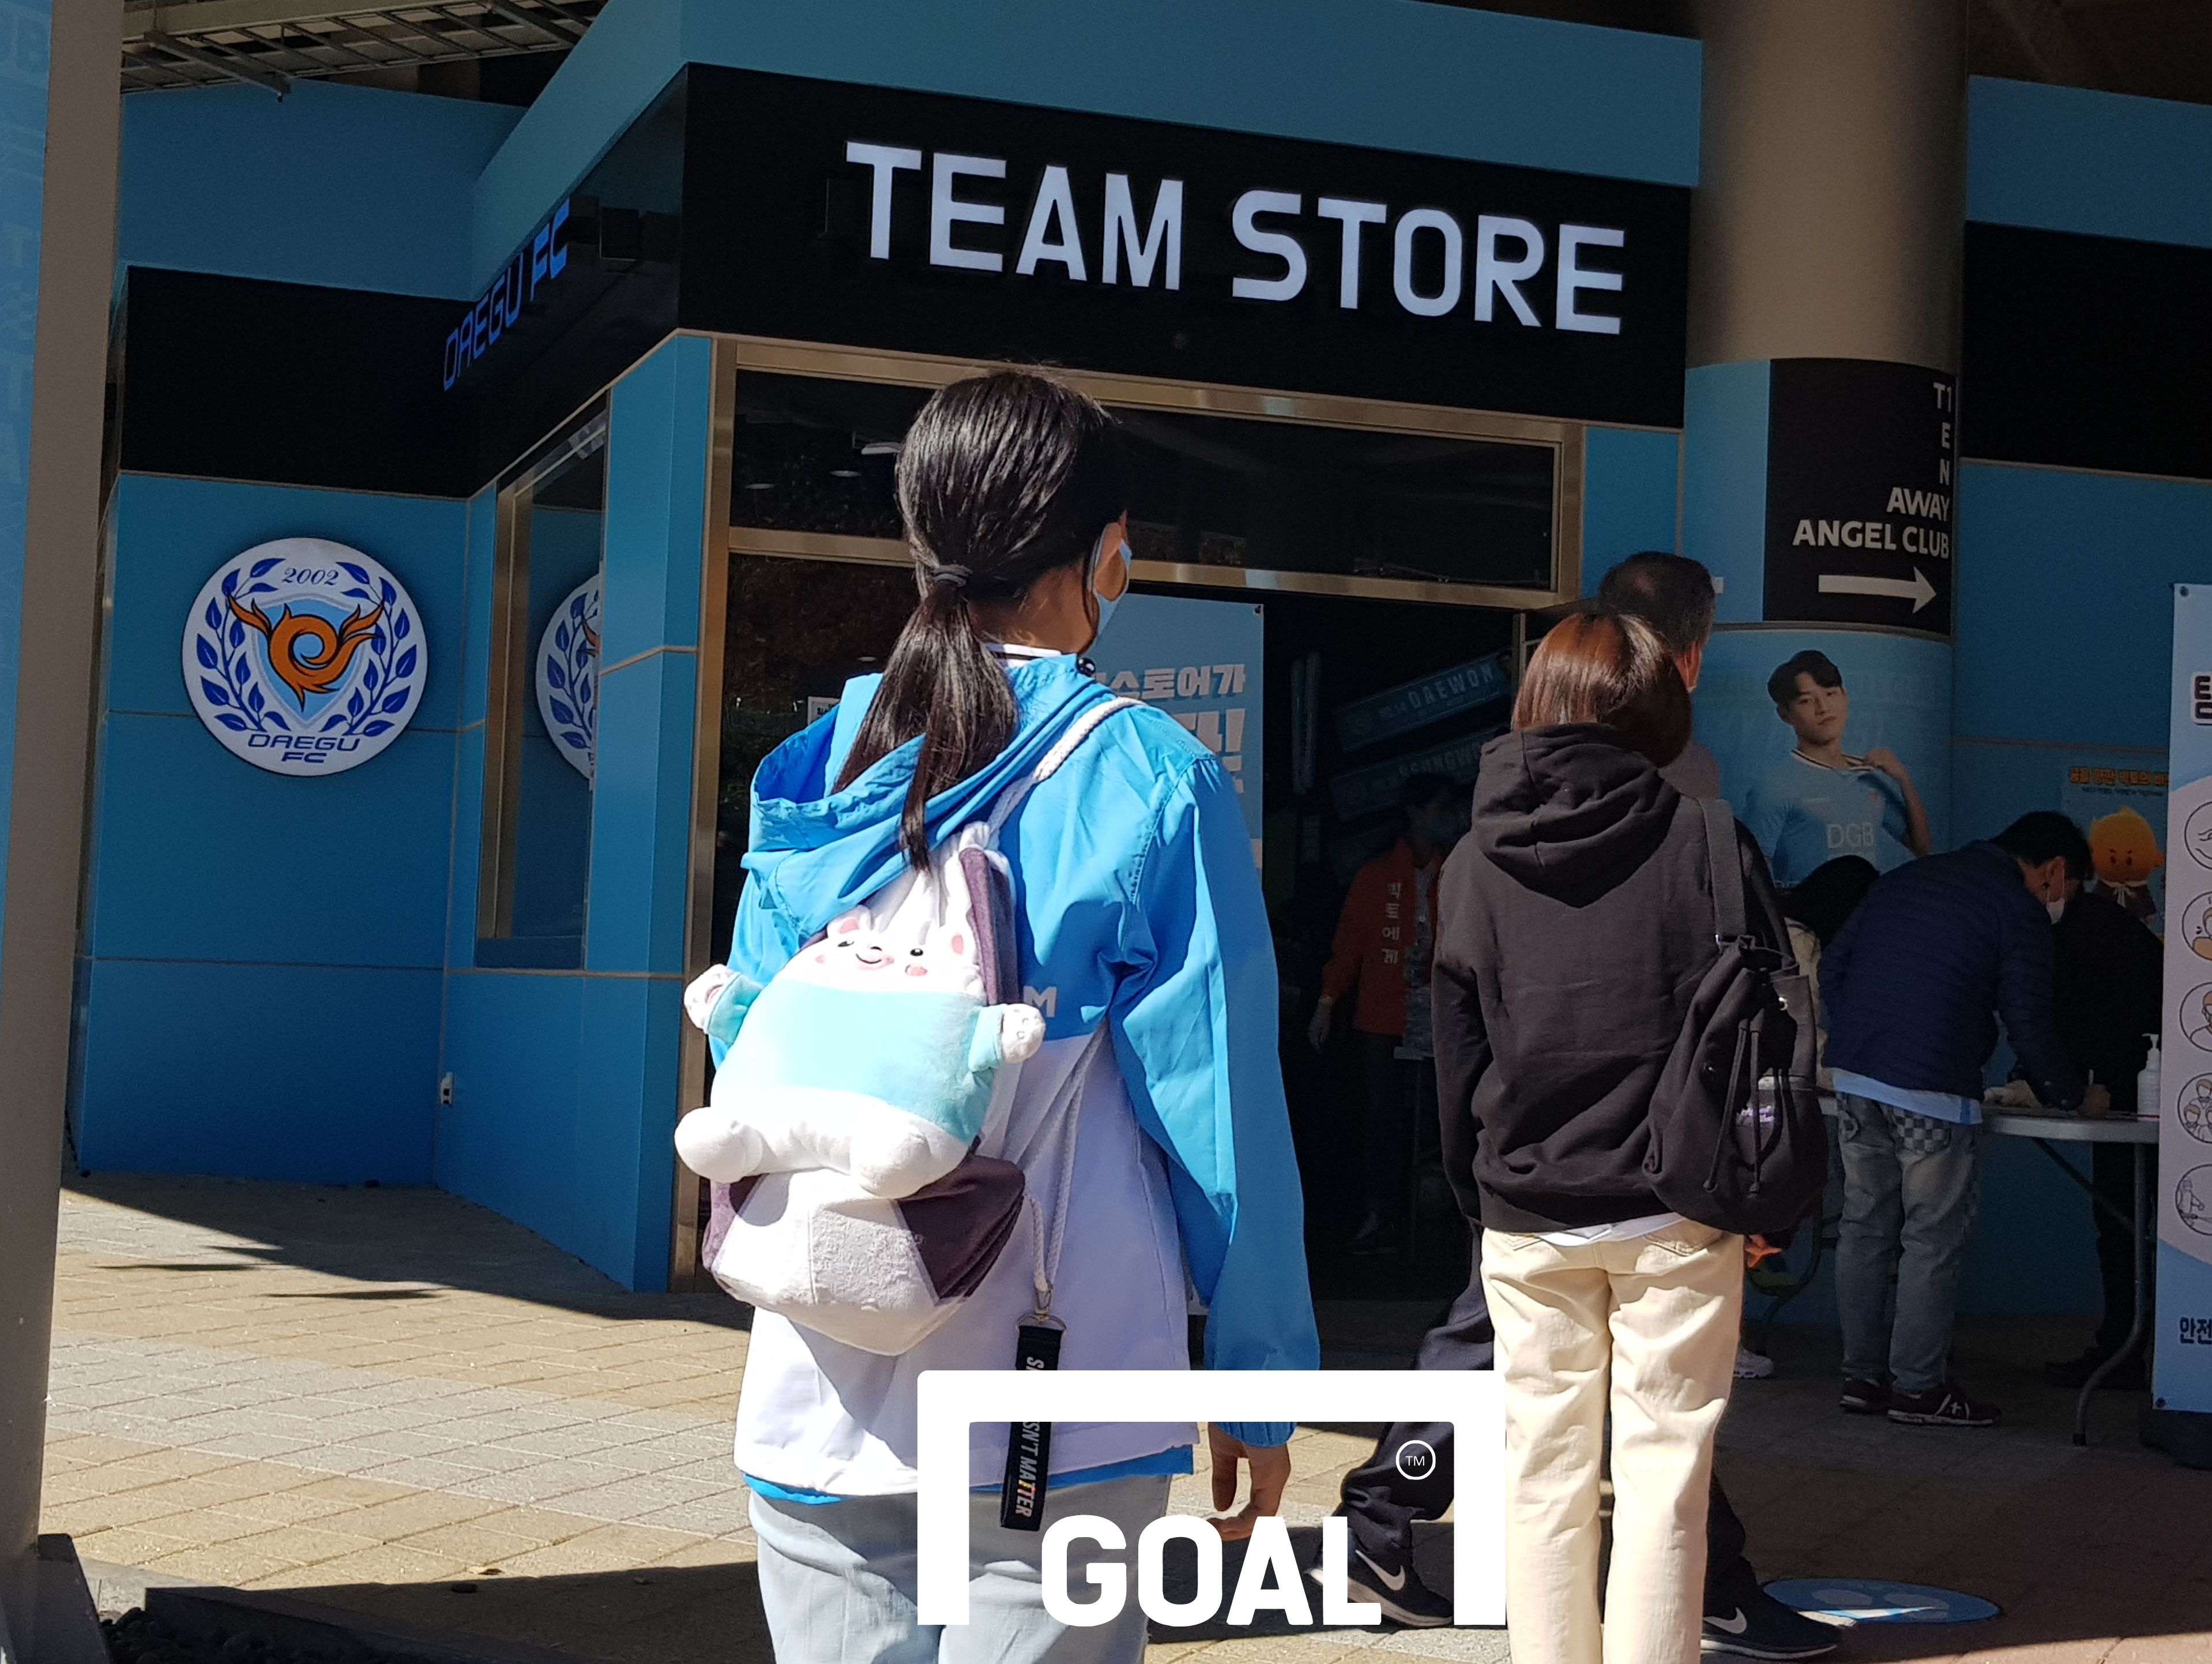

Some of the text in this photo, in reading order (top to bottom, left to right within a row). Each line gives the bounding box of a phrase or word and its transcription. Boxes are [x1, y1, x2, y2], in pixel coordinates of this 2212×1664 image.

[846, 142, 1624, 335] TEAM STORE
[443, 198, 570, 392] DAEGU FC
[1886, 487, 1950, 521] AWAY
[1792, 520, 1949, 558] ANGEL CLUB
[281, 568, 339, 586] 2002
[1095, 663, 1246, 700] 스토어가
[1408, 663, 1495, 709] DAEWON
[247, 734, 360, 751] DAEGU
[281, 752, 327, 764] FC
[1827, 821, 1874, 850] DGB
[1015, 1356, 1045, 1517] S SN'T MATTER
